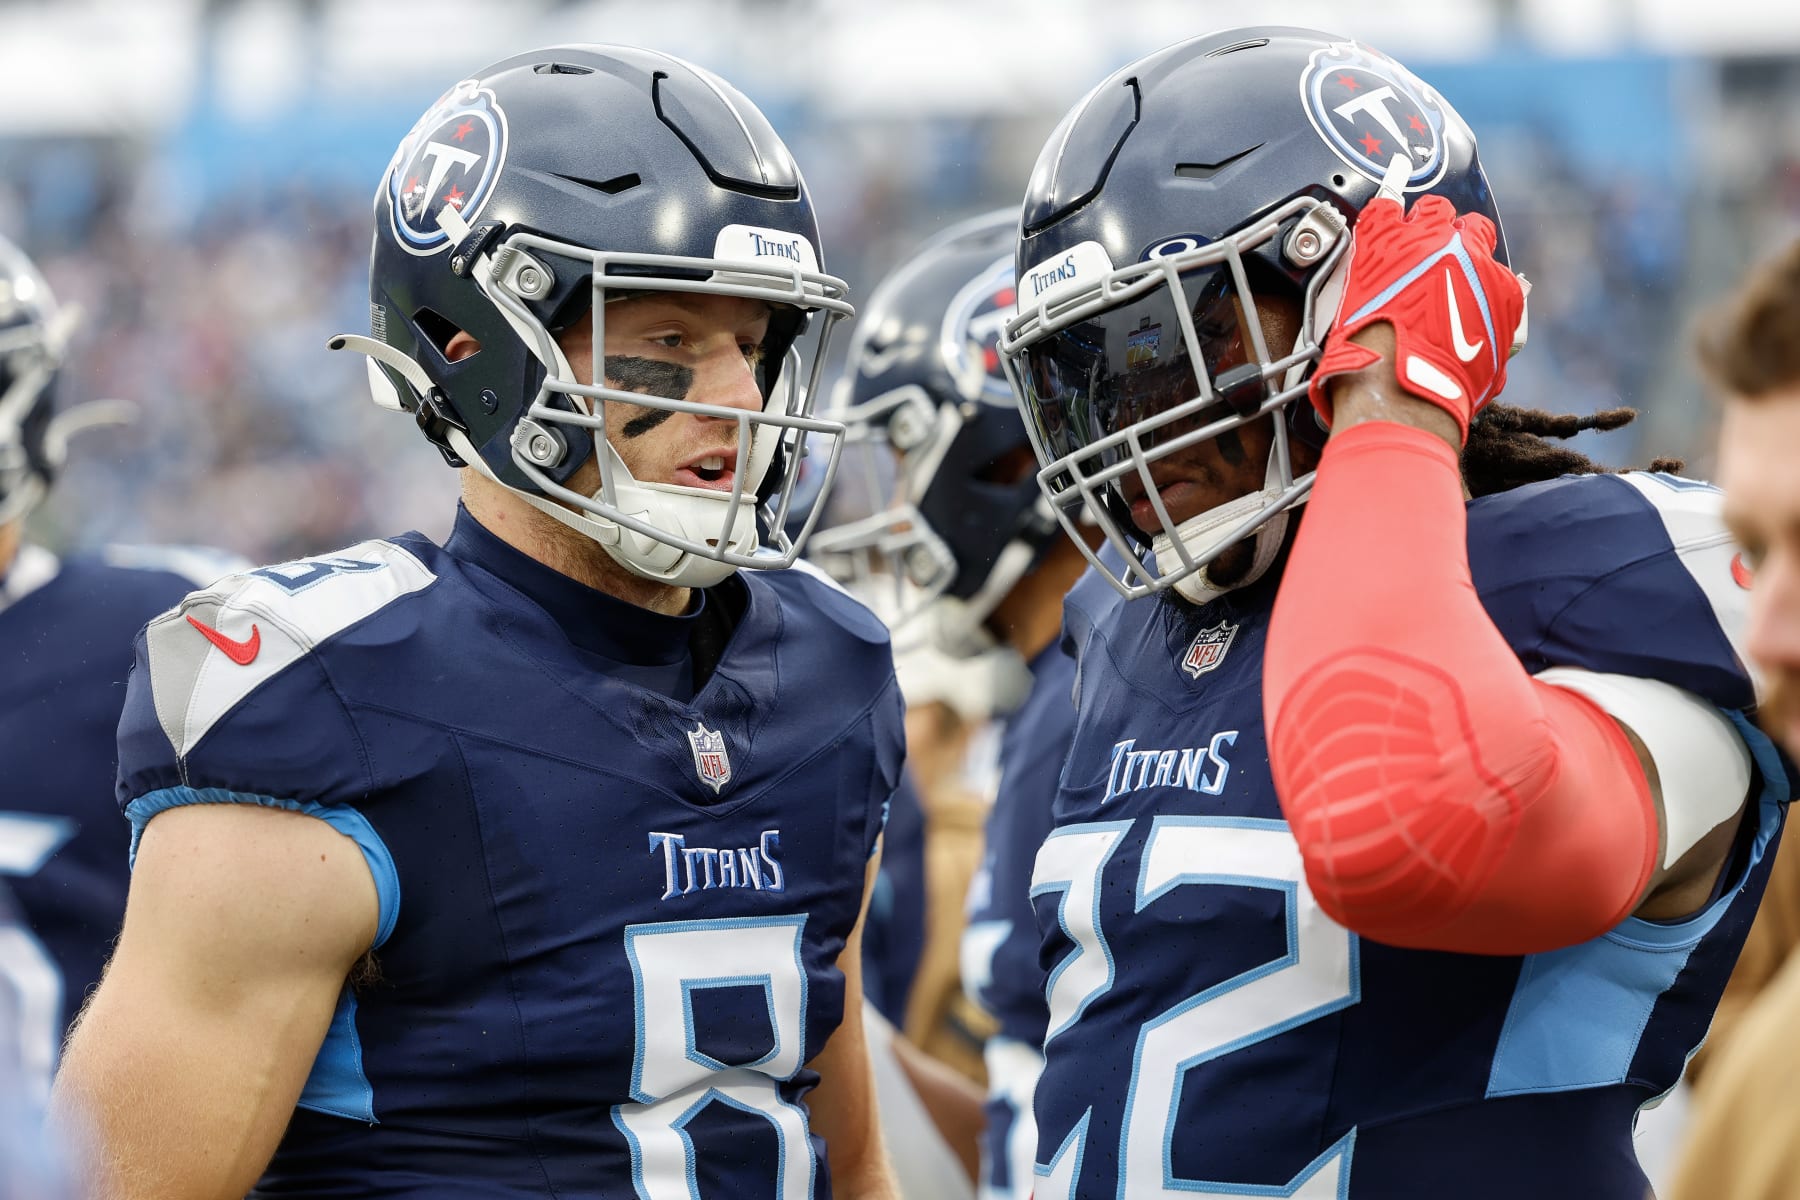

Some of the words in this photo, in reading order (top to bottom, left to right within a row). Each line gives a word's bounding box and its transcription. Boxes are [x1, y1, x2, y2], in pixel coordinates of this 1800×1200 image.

[420, 140, 482, 225] T
[749, 232, 801, 263] TITANS
[1030, 254, 1077, 297] TITANS
[1188, 644, 1221, 666] NFL
[700, 754, 727, 779] NFL
[1101, 730, 1240, 804] TITANS
[648, 829, 785, 901] TITANS
[610, 912, 817, 1200] 8
